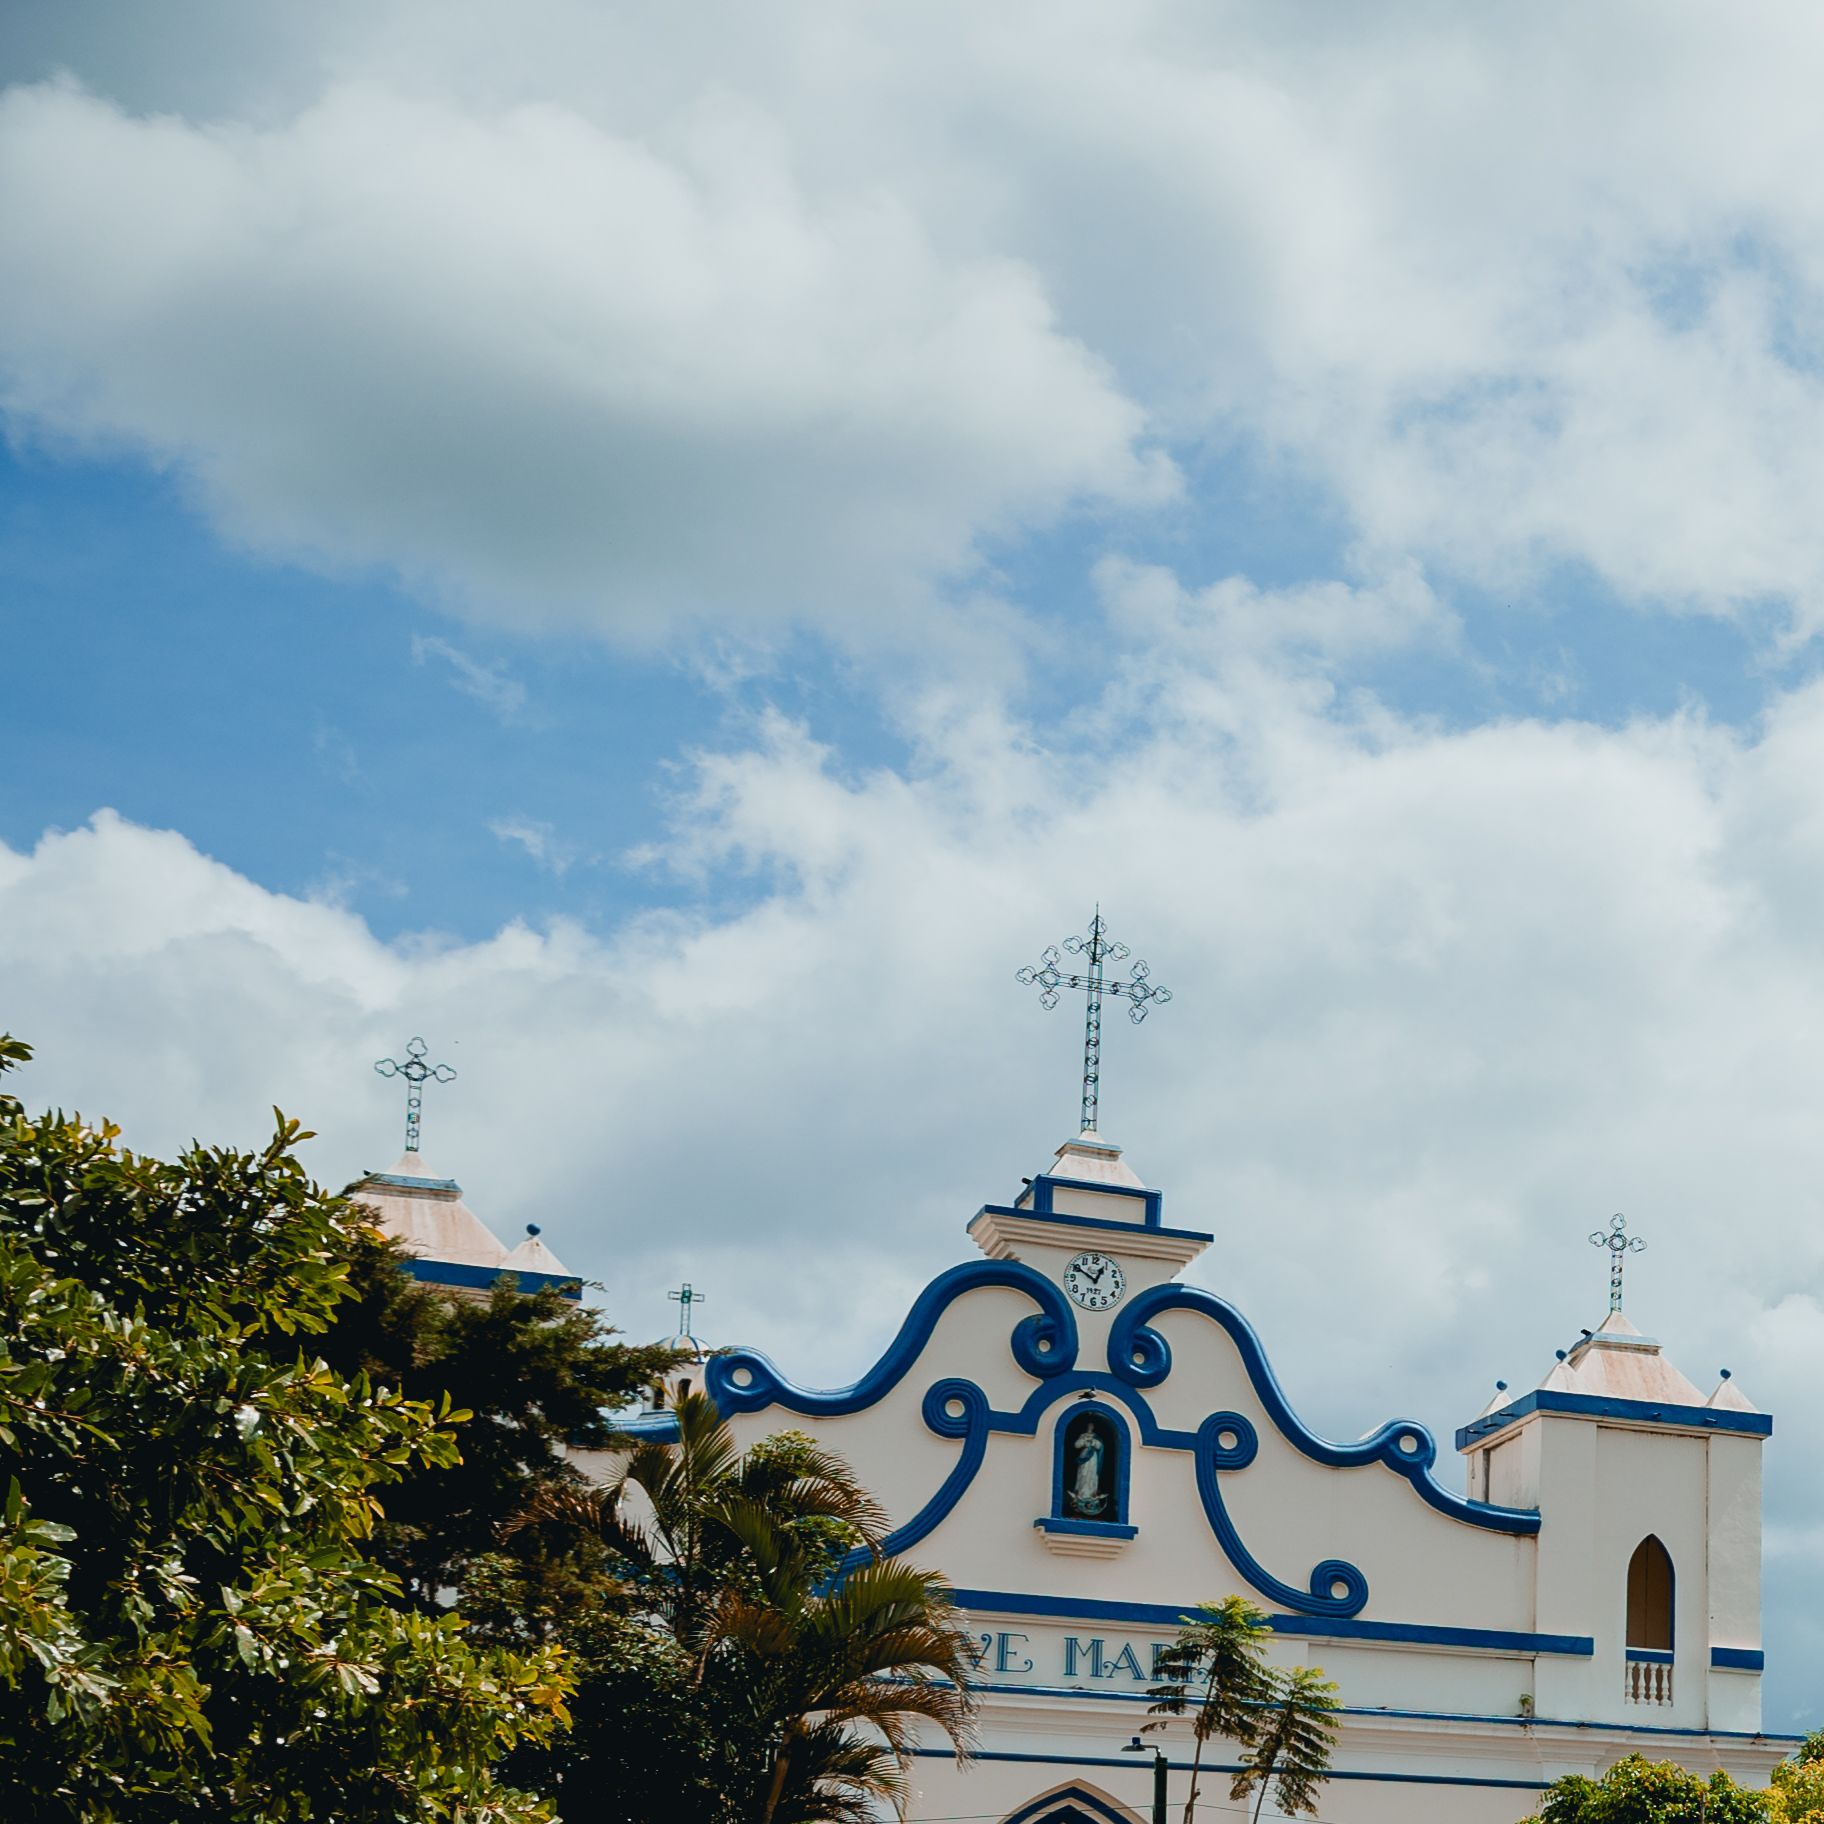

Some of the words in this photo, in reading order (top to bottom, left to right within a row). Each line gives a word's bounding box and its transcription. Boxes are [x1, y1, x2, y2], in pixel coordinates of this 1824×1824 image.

[1092, 1256, 1100, 1265] 12
[1070, 1274, 1076, 1282] 9
[1111, 1270, 1117, 1278] 2
[1072, 1284, 1078, 1293] 8
[1080, 1293, 1086, 1302] 7
[1090, 1297, 1096, 1306] 6
[1101, 1296, 1107, 1305] 5
